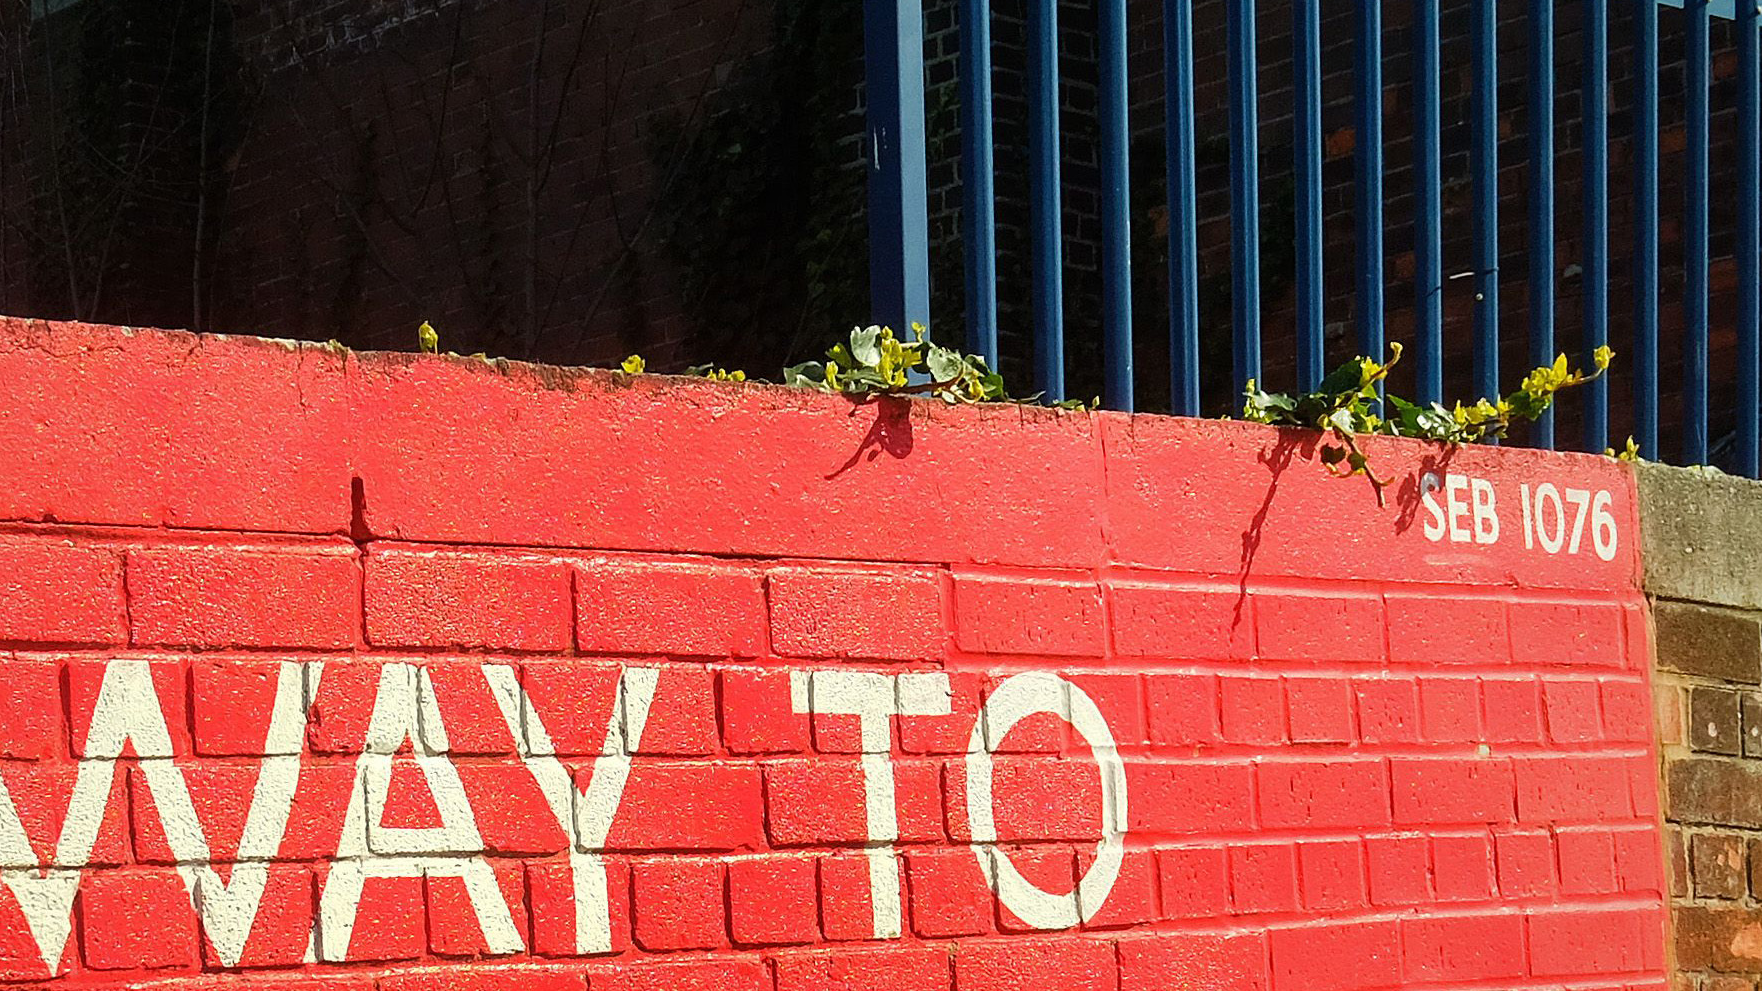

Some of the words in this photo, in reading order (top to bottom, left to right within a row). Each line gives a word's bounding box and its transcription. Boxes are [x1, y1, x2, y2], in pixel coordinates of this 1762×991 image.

[1420, 471, 1500, 545] SEB
[1520, 482, 1618, 562] 1076
[791, 668, 1128, 938] TO
